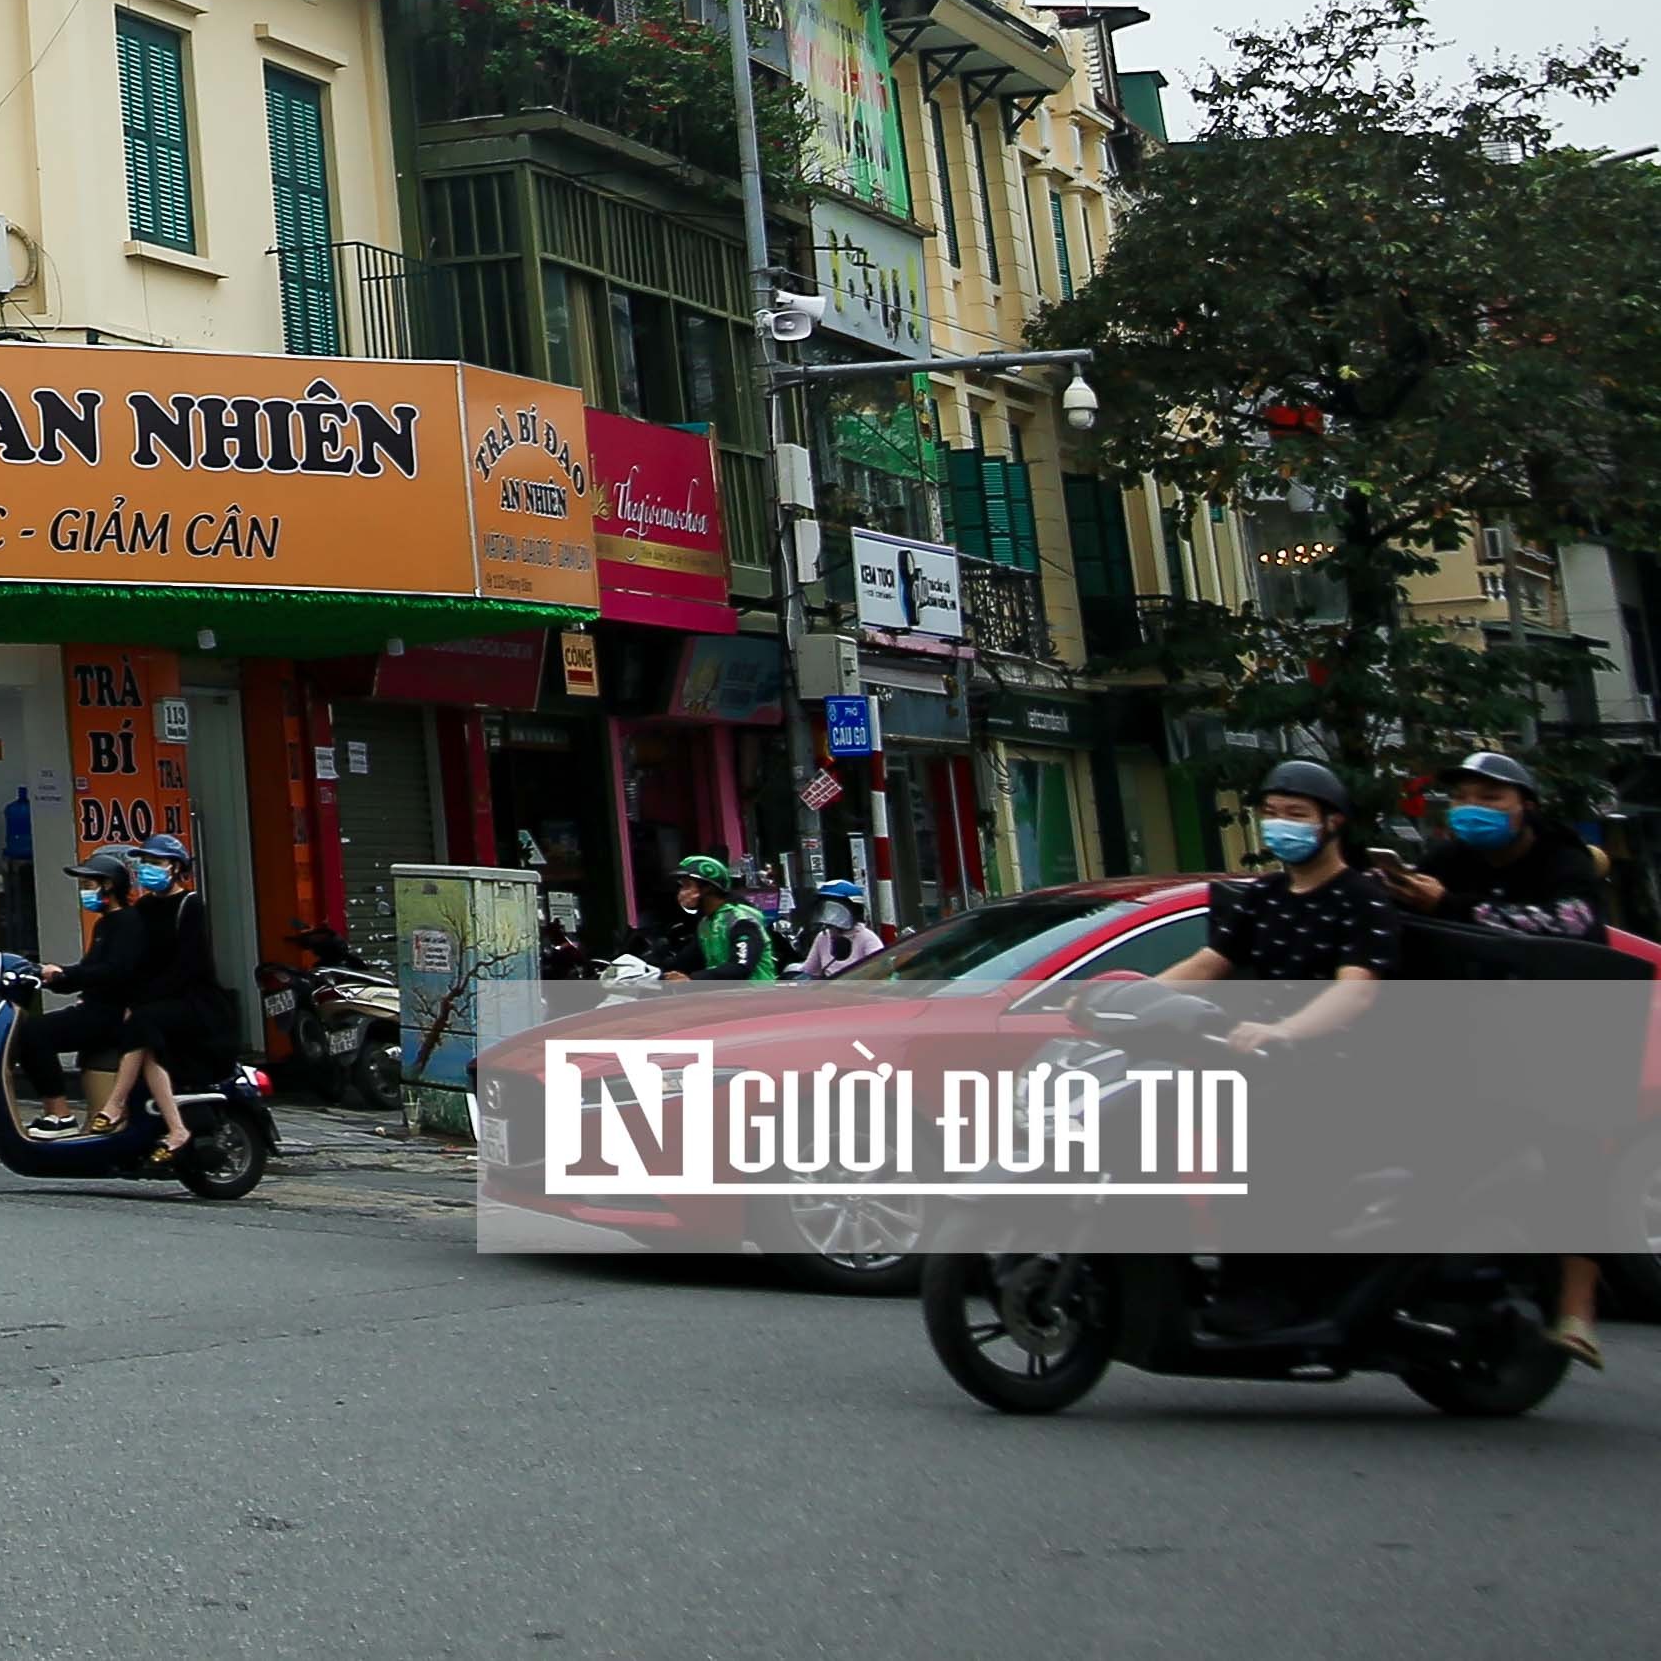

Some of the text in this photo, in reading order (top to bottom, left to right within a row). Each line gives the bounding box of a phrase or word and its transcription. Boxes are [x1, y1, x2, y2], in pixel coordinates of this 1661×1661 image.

[126, 377, 420, 479] NHIÊN
[474, 404, 586, 497] TRÀ BÍ ĐAO
[500, 476, 568, 519] AN NHIÊN
[50, 495, 171, 557] GIẢM
[184, 504, 281, 559] CÂN
[74, 654, 143, 707] TRÀ
[165, 706, 187, 725] 113
[88, 719, 138, 775] BÍ
[79, 798, 154, 843] ĐAO
